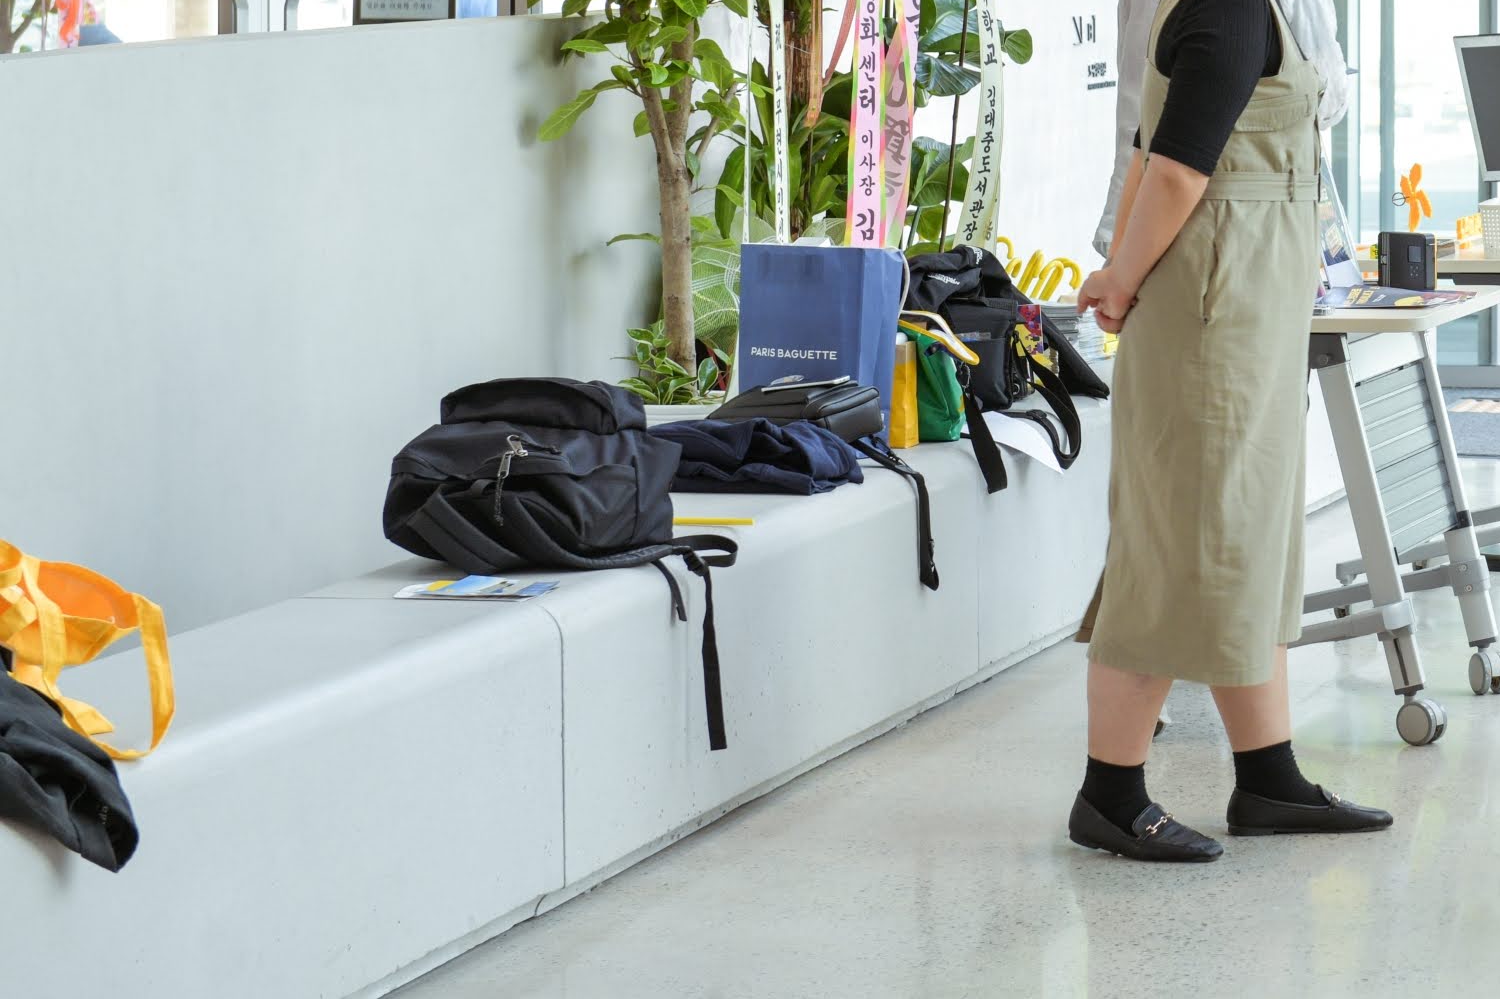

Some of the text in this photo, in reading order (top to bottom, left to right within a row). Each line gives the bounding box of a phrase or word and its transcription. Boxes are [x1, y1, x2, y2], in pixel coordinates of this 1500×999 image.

[858, 129, 876, 197] 이사장
[963, 85, 996, 242] 김대중도서관장
[855, 208, 876, 241] 김
[750, 346, 838, 360] PARIS BAGUETTE
